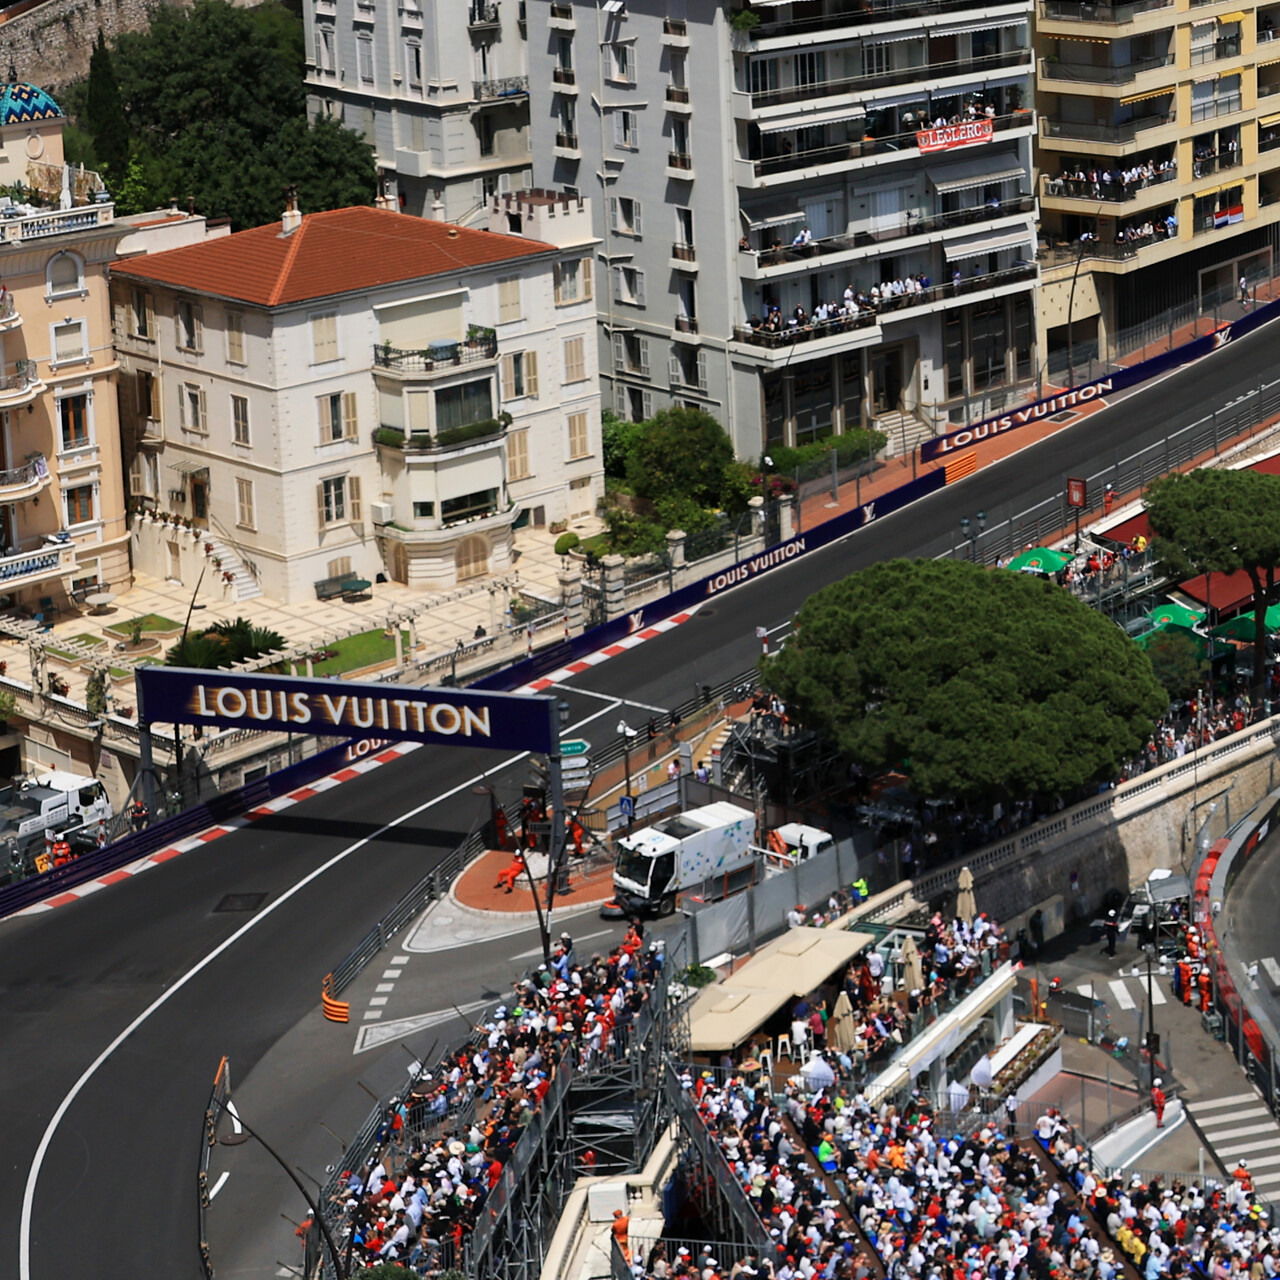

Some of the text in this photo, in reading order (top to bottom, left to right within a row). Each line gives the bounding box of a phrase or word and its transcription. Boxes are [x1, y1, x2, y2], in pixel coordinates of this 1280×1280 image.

[928, 122, 982, 145] LECLERC
[941, 377, 1113, 452] LOUIS VUITTON
[707, 537, 806, 594] LOUIS VUITTON
[197, 684, 492, 738] LOUIS VUITTON
